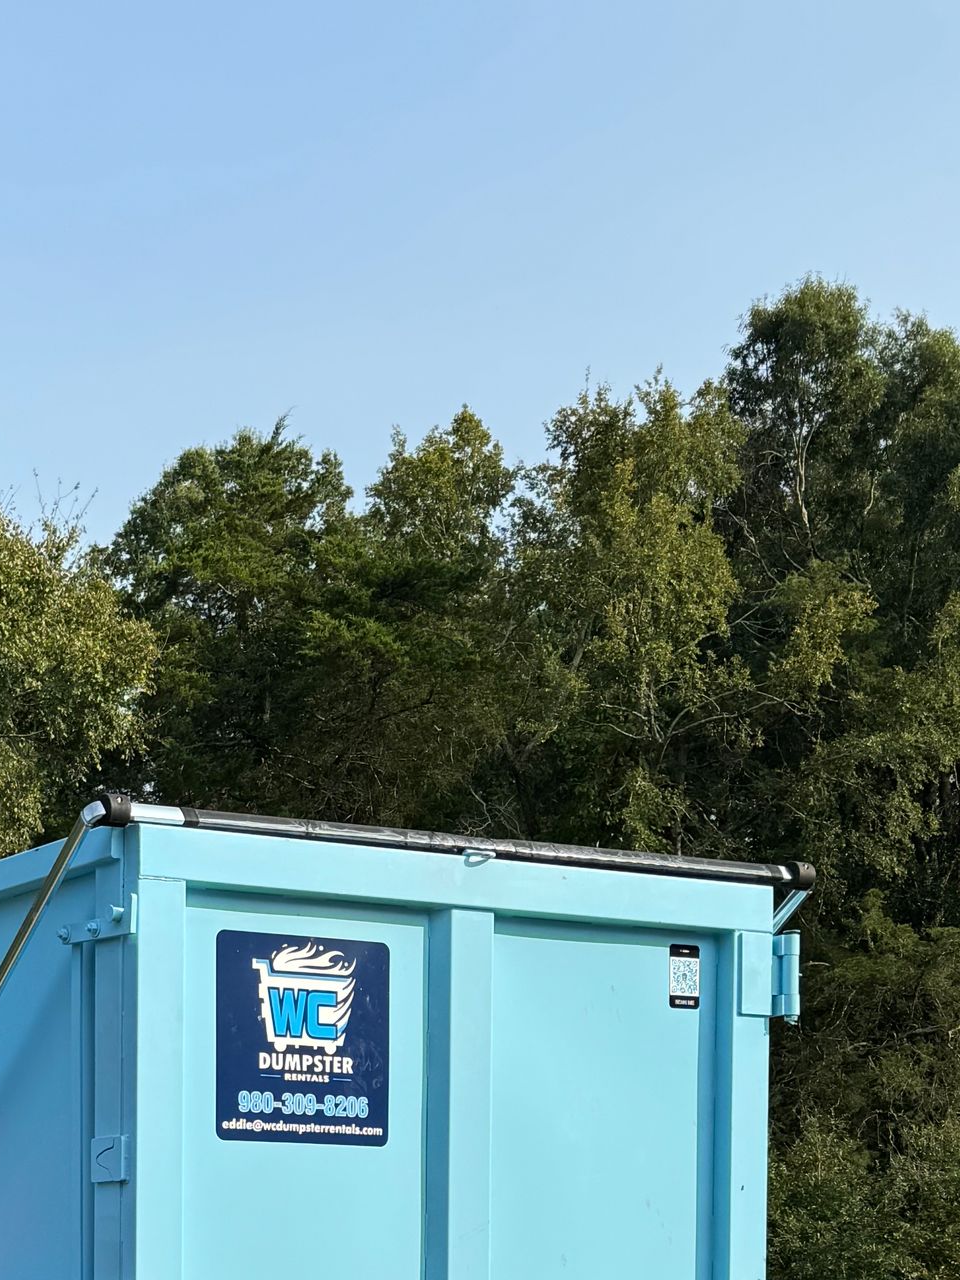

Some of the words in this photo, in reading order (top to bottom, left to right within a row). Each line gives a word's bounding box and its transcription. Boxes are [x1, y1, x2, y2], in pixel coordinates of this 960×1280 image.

[268, 986, 338, 1041] WC
[258, 1052, 354, 1075] DUMPSTER
[284, 1072, 330, 1083] RENTALS
[238, 1090, 369, 1119] 980-309-8206
[222, 1118, 383, 1136] eddie@wcdumpsterrentals.com
